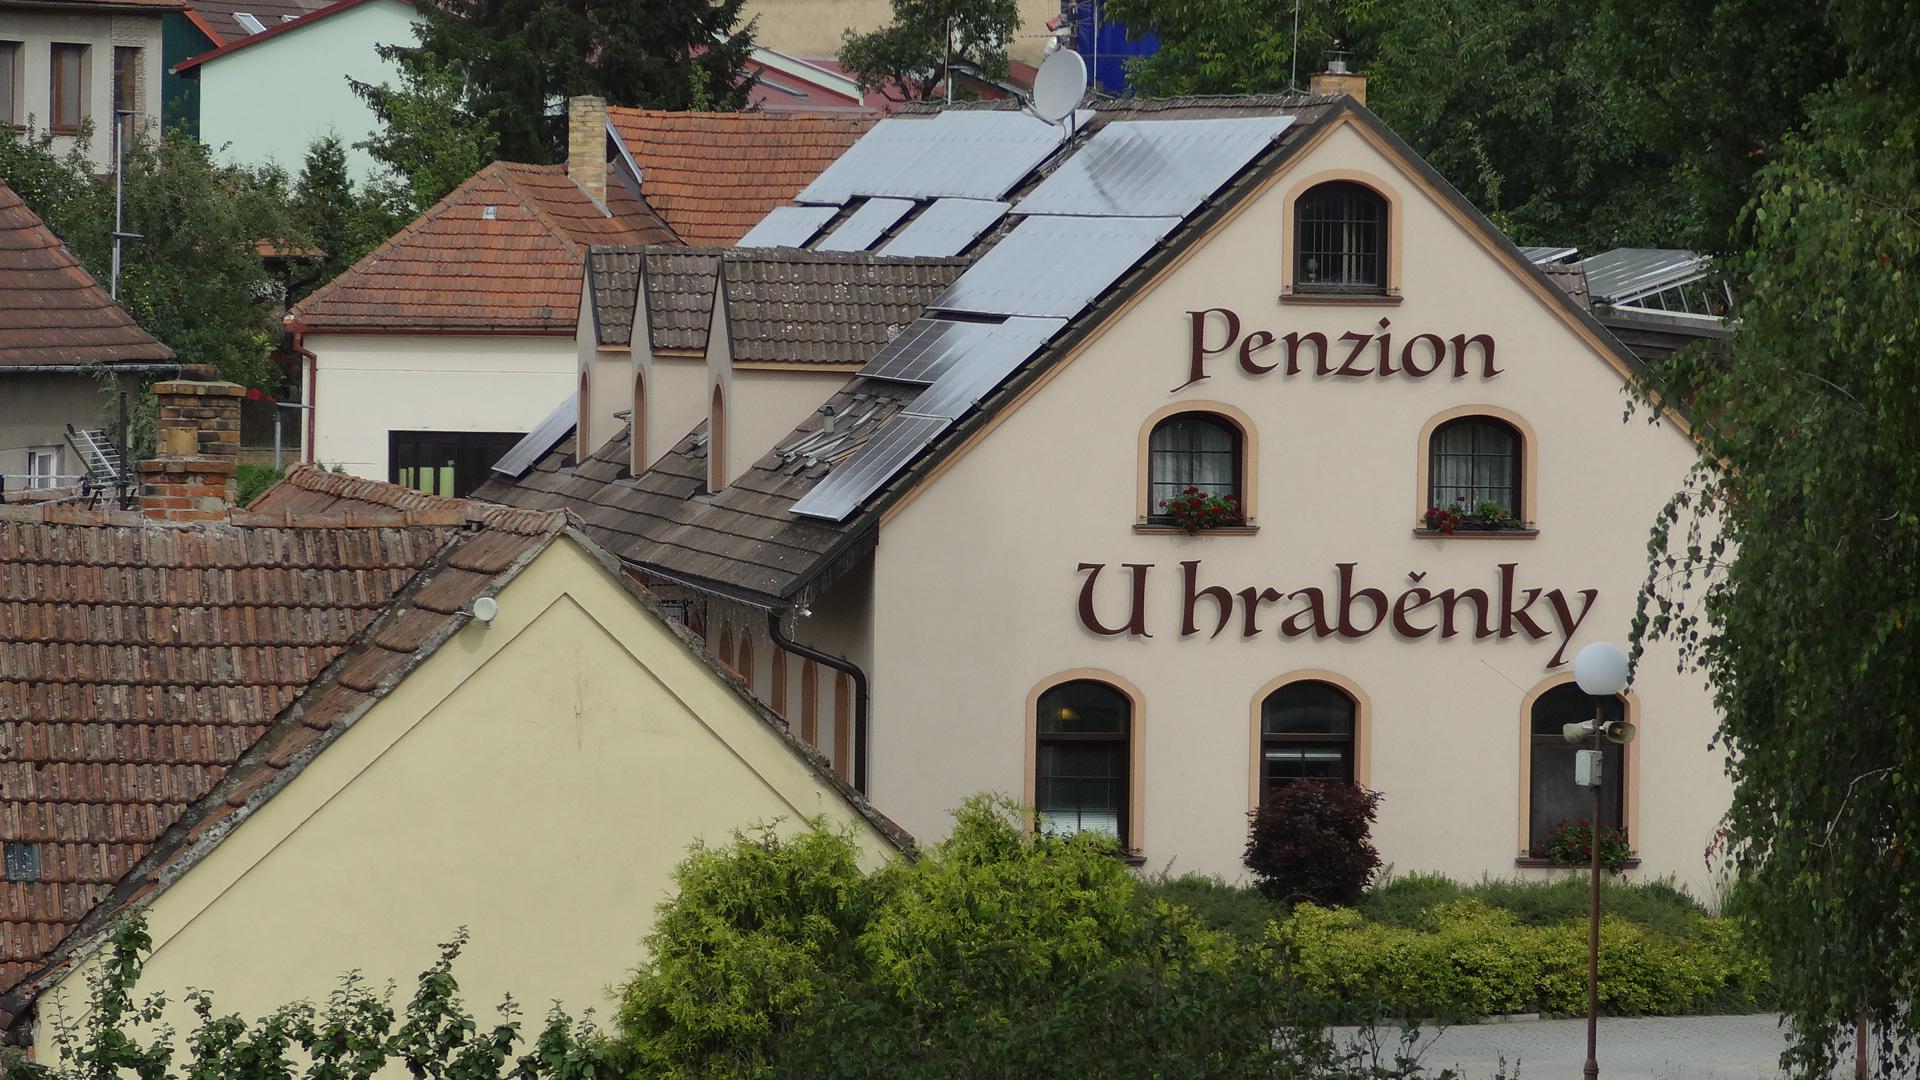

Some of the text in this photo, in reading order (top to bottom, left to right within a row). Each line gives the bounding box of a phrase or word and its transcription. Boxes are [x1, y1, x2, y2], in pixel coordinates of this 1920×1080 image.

[1170, 307, 1505, 394] Penzion
[1076, 559, 1599, 671] U hraběnky
